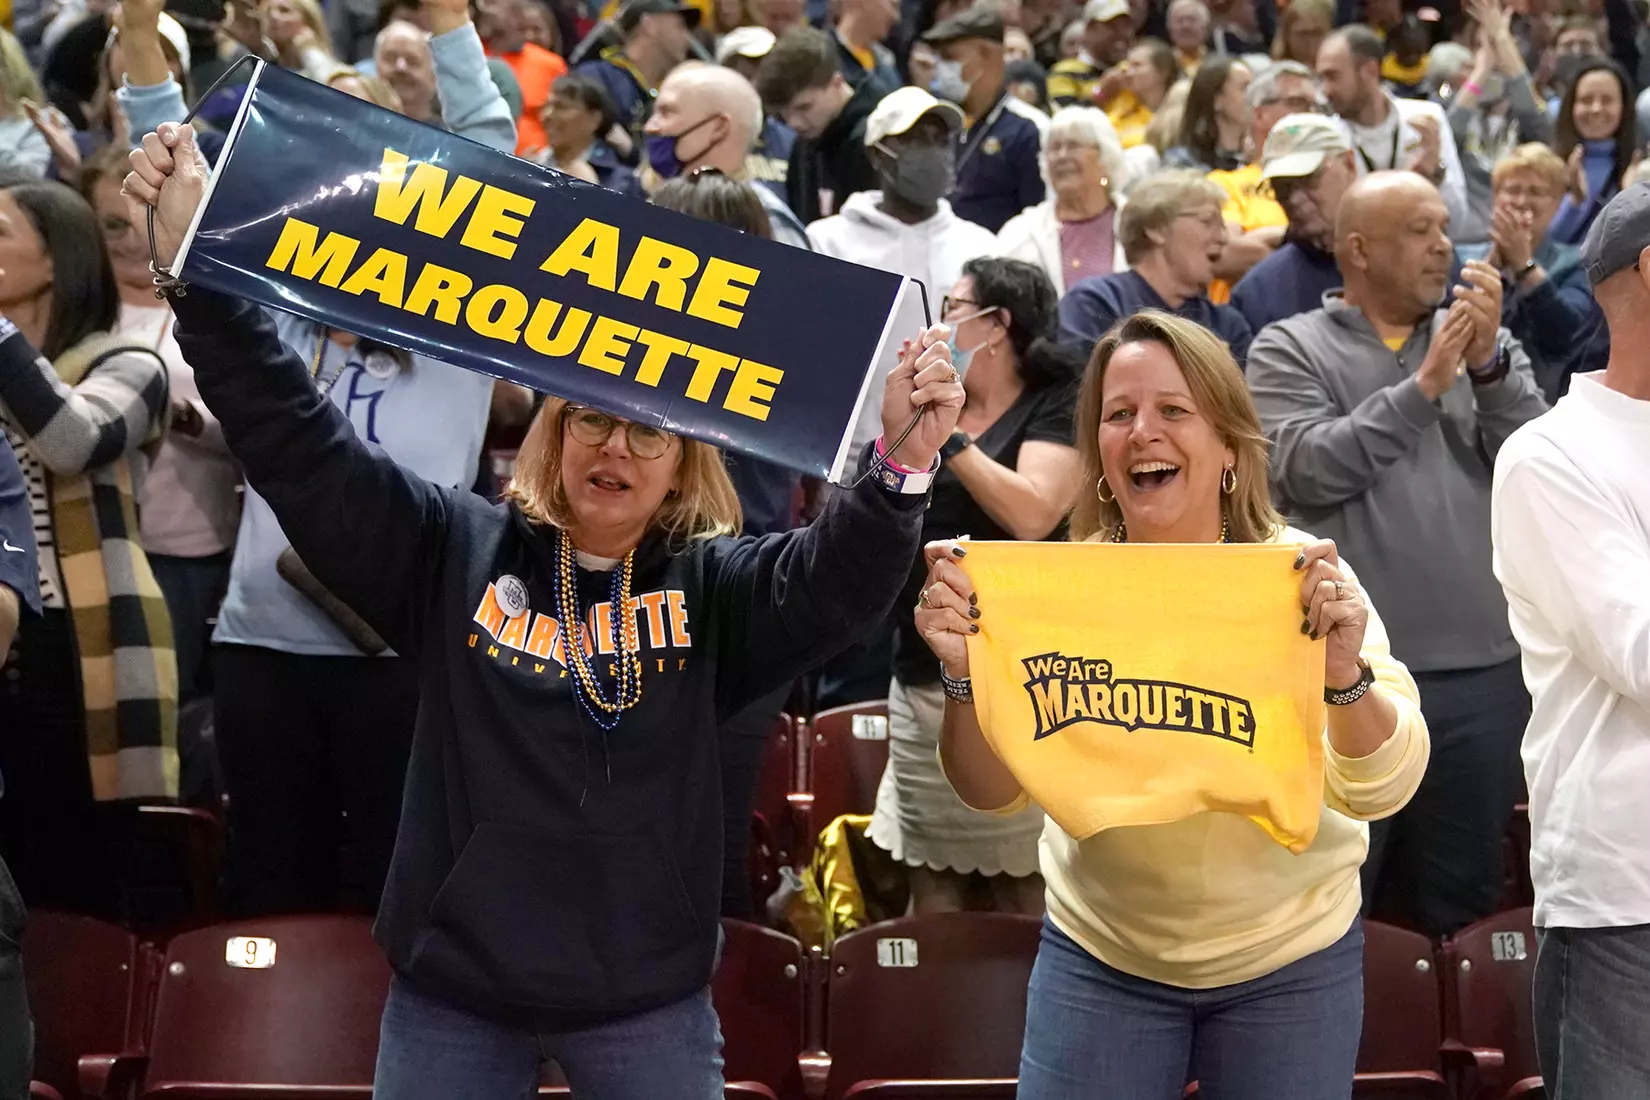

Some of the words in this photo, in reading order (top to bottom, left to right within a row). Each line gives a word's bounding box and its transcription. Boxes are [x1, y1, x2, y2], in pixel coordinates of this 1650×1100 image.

[373, 148, 536, 260] WE
[540, 217, 760, 329] ARE
[266, 217, 784, 421] MARQUETTE
[473, 581, 691, 668] MARQETTE
[467, 633, 687, 679] UNIVESITY
[1027, 655, 1066, 679] We
[1067, 658, 1109, 681] Are
[1029, 677, 1252, 743] MARQUETTE
[245, 940, 257, 965] 9
[889, 940, 904, 965] 11
[1499, 934, 1516, 958] 13
